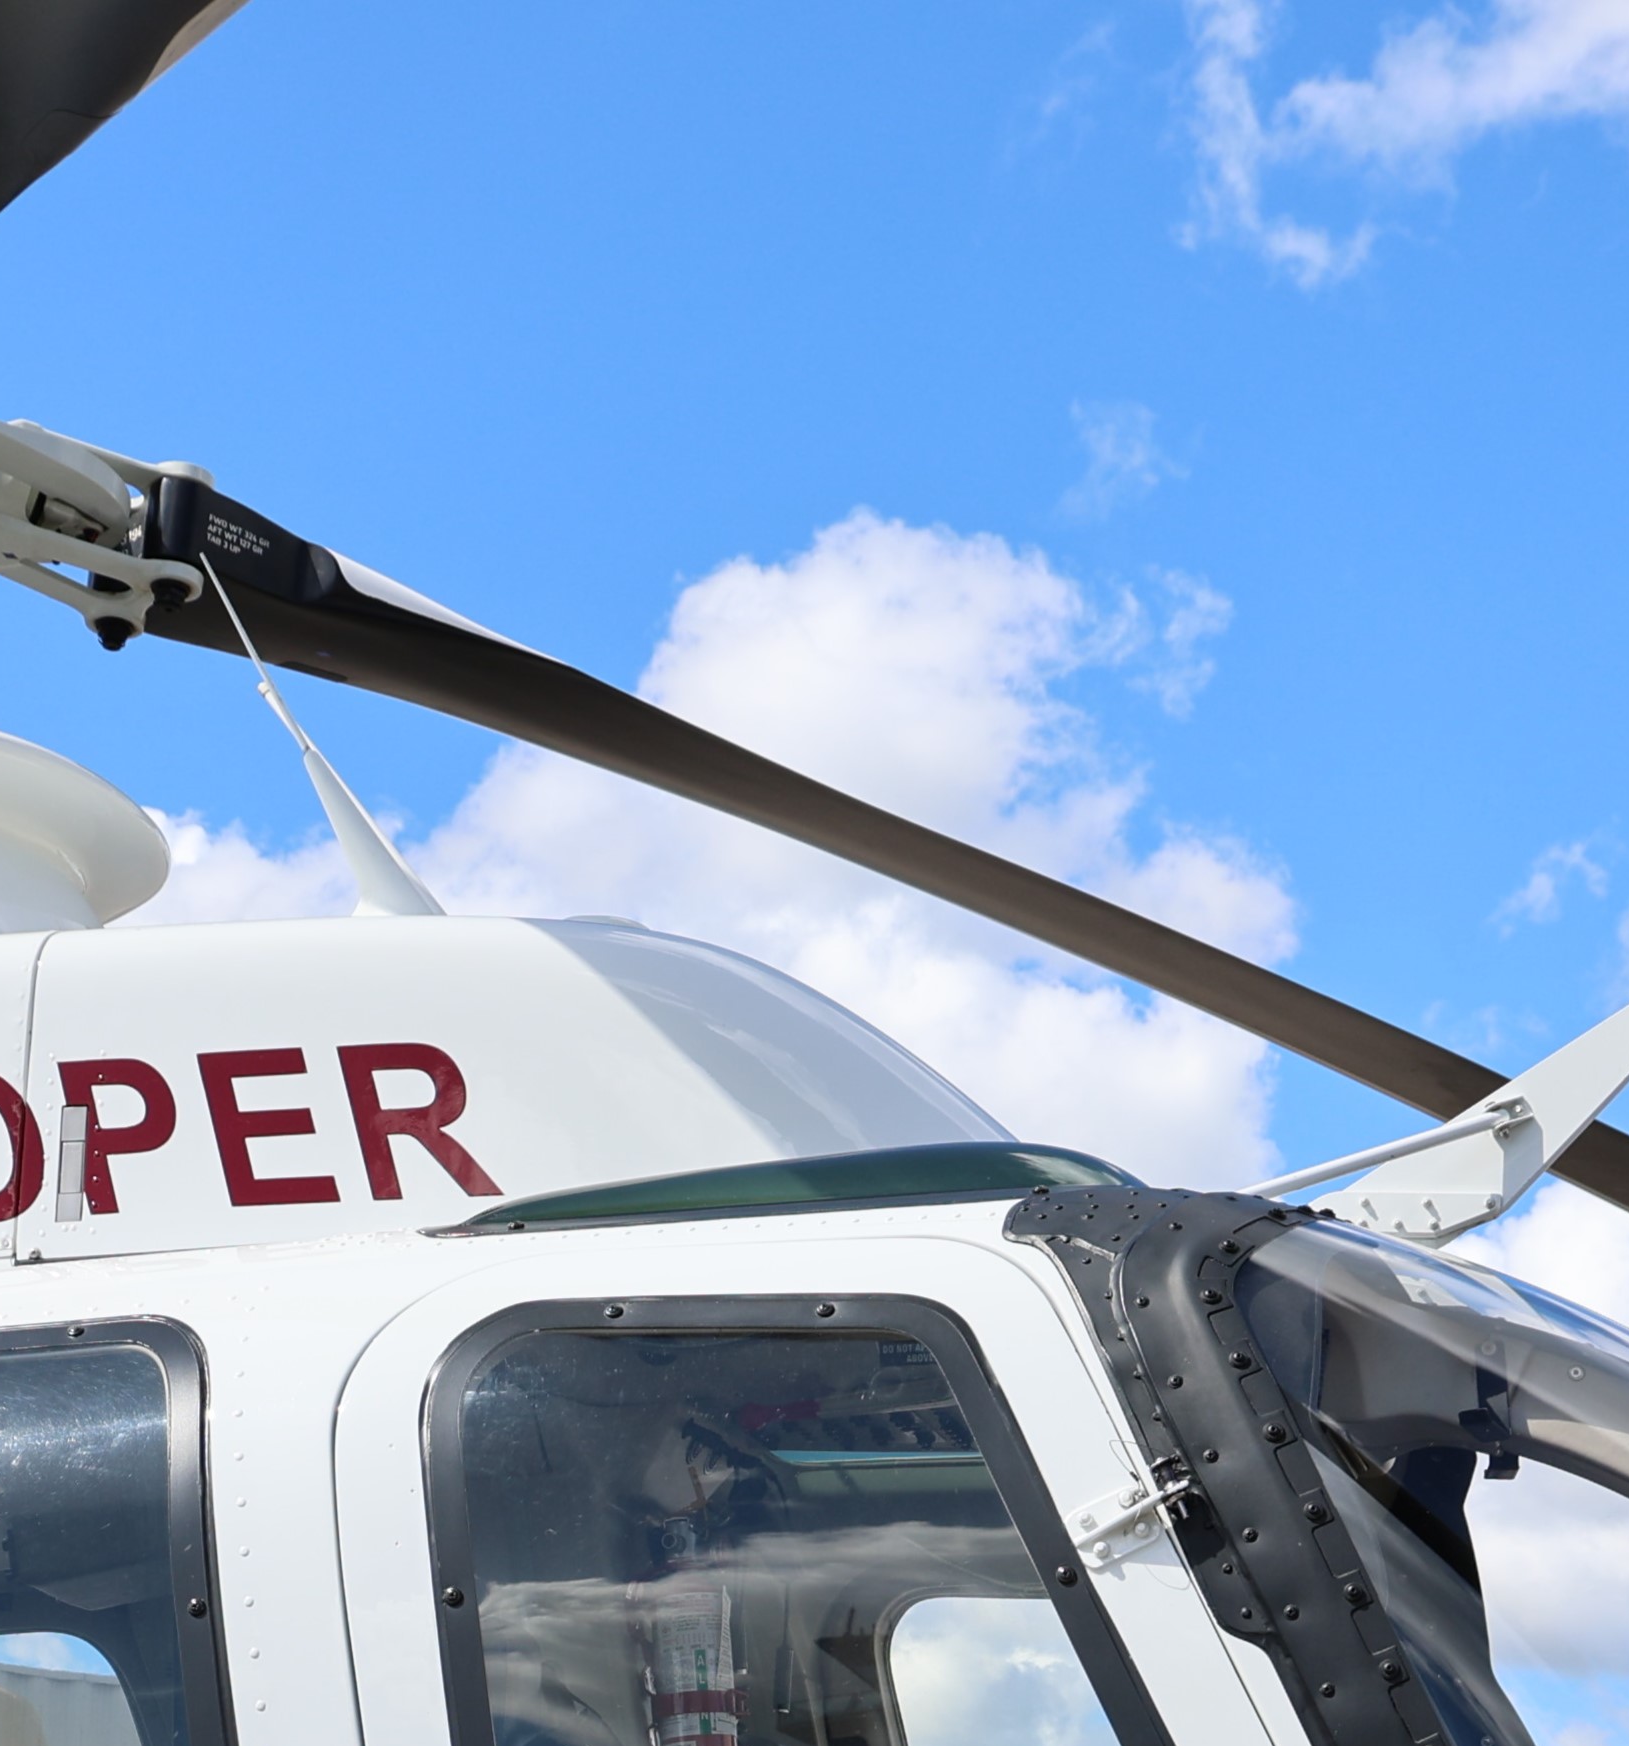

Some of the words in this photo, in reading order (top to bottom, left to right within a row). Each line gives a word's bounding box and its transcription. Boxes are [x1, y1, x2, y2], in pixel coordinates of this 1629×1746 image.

[207, 524, 222, 537] AFT
[224, 531, 239, 544] WT
[208, 513, 227, 528] FWD
[229, 523, 242, 535] WT
[229, 544, 242, 554] UP
